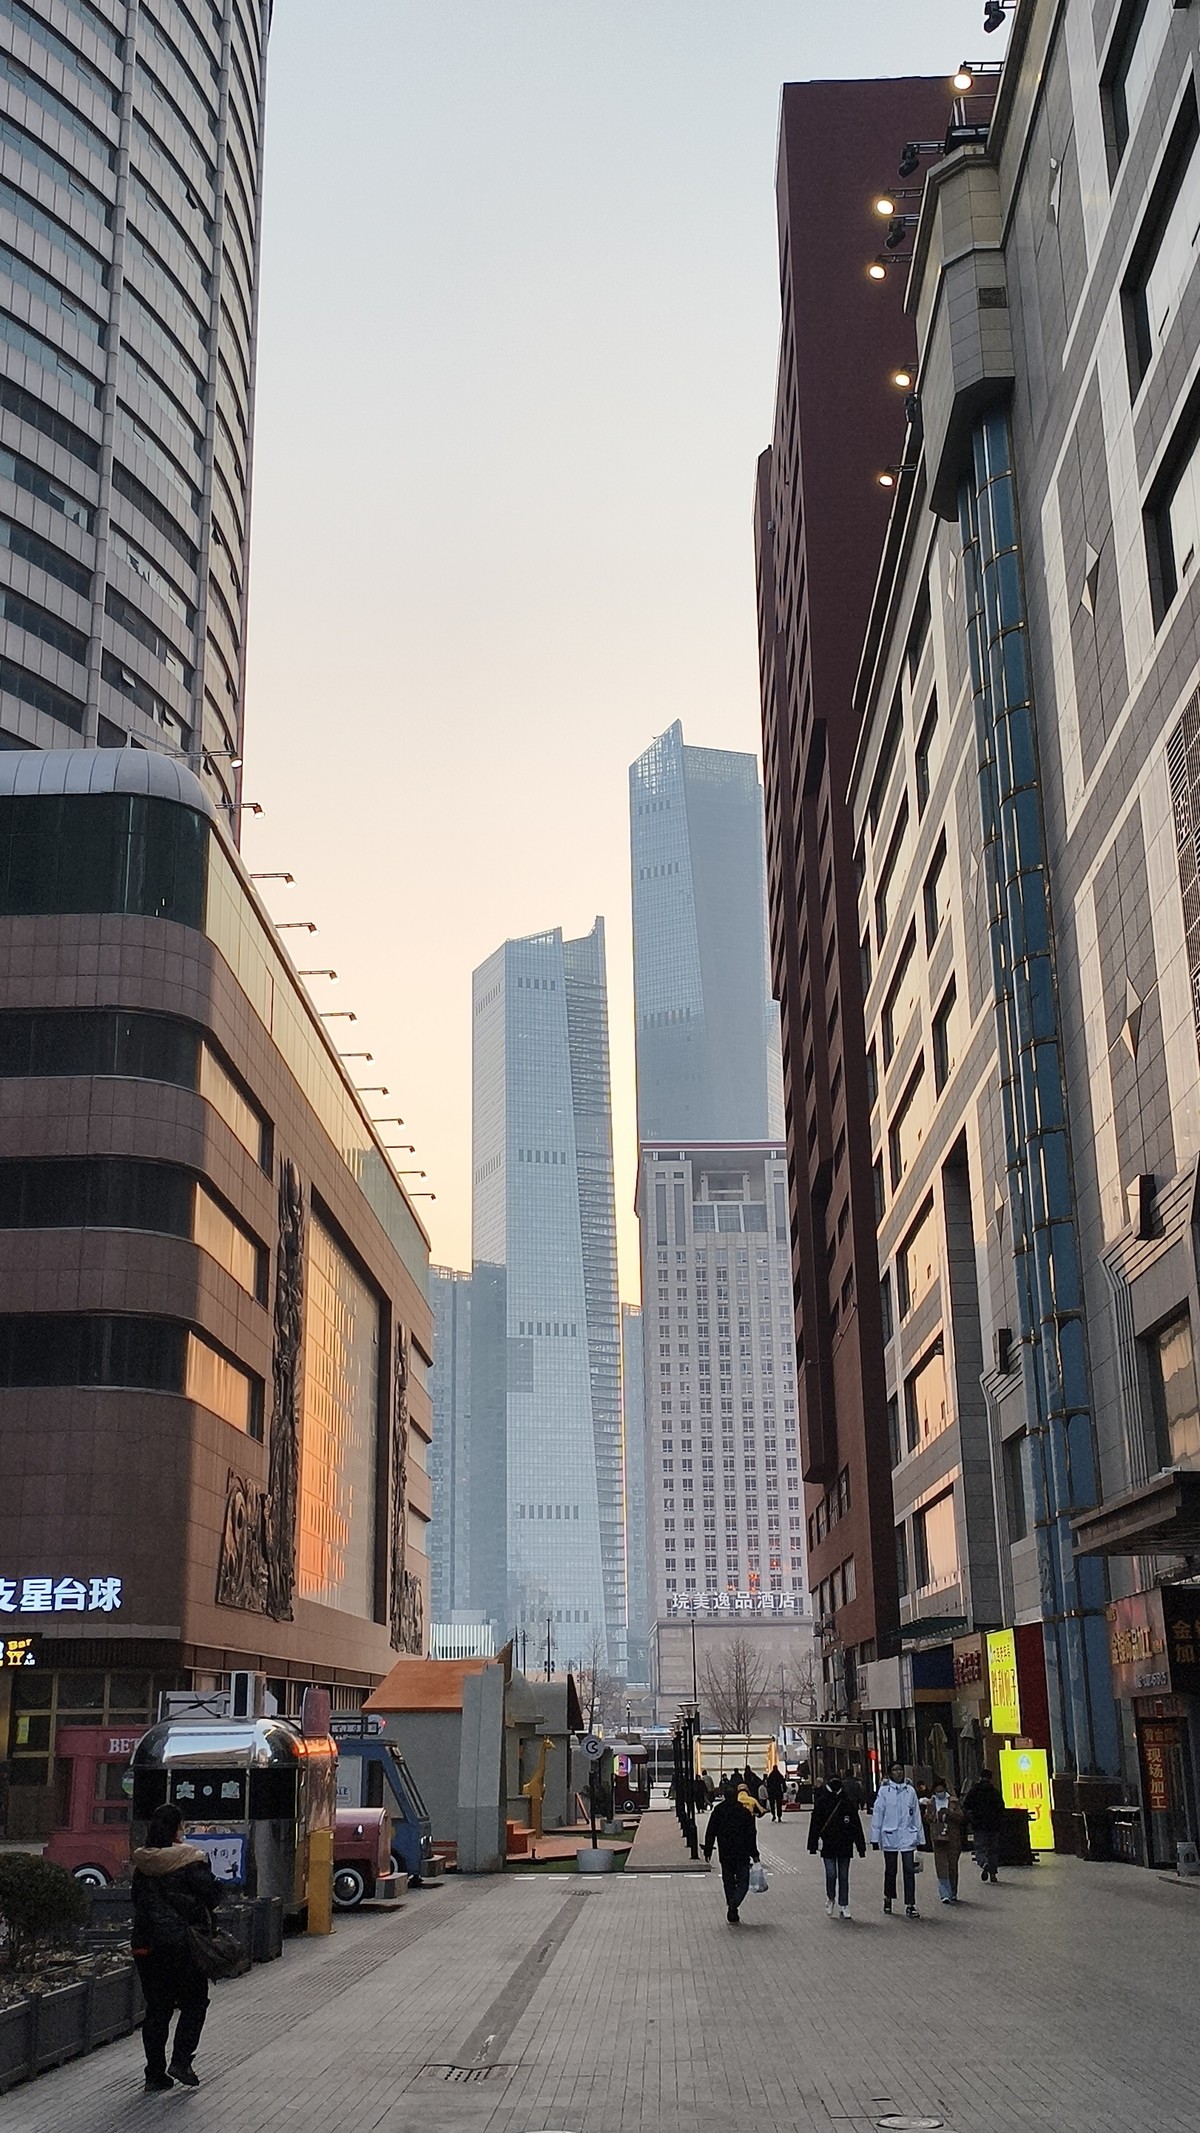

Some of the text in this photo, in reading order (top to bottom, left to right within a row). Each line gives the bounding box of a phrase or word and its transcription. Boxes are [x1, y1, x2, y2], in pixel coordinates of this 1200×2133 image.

[672, 1591, 796, 1610] 琓美逸品酒店
[1146, 1748, 1167, 1809] 现场加工
